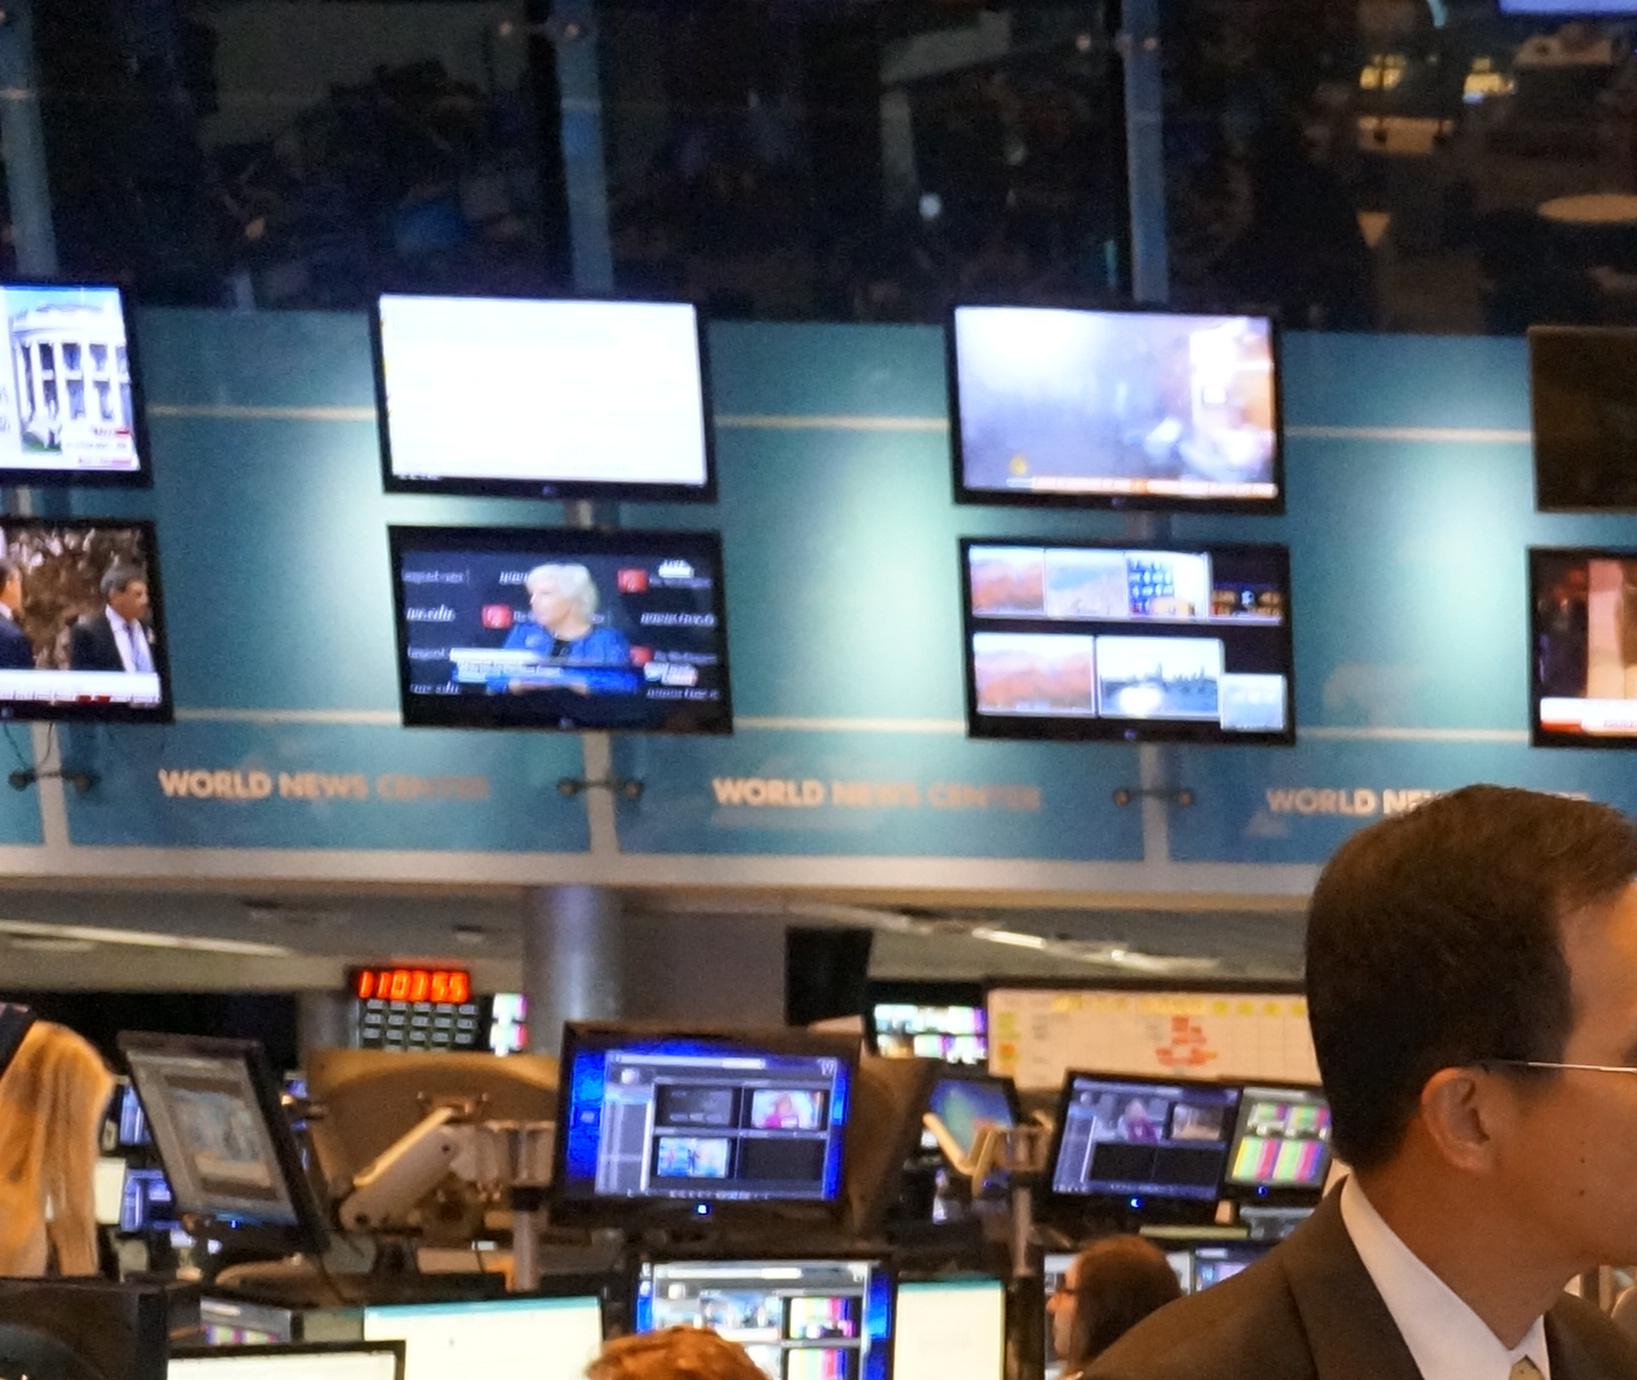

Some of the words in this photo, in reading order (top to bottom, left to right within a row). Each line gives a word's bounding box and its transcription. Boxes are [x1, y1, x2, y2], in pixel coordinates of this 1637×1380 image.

[158, 768, 272, 799] WORLD
[278, 771, 369, 799] NEWS
[376, 773, 489, 800] CENTER
[712, 777, 825, 807] WORLD
[831, 780, 919, 808] NEWS
[927, 782, 1041, 811] CENTER
[1266, 787, 1377, 815] WORLD
